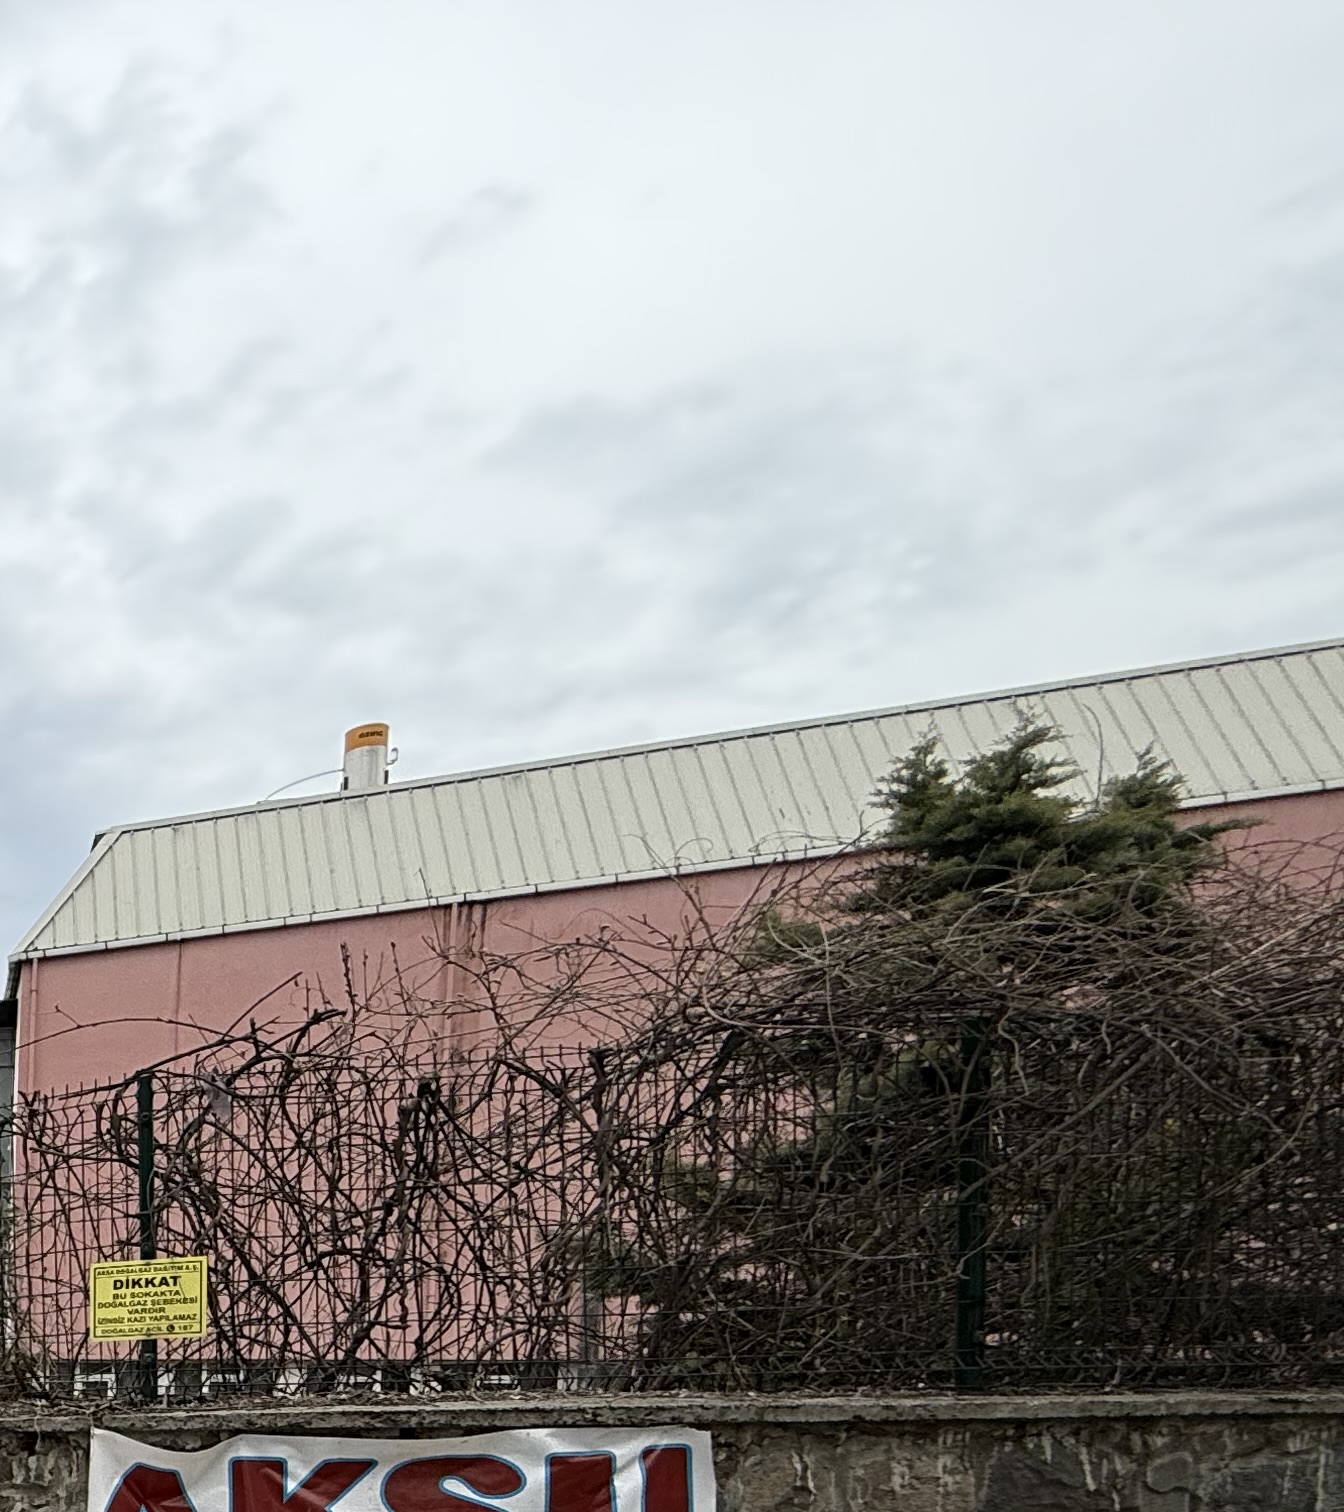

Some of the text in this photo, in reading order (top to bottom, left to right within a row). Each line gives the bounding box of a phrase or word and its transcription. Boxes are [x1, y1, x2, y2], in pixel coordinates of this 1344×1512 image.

[113, 1275, 182, 1291] DİKKAT
[130, 1289, 182, 1299] SOKAKTA
[97, 1296, 198, 1309] DOĞALGAZ ŞEBEKESİ
[148, 1313, 198, 1322] YAPILAMAZ
[101, 1326, 144, 1335] DOĞALGAZ
